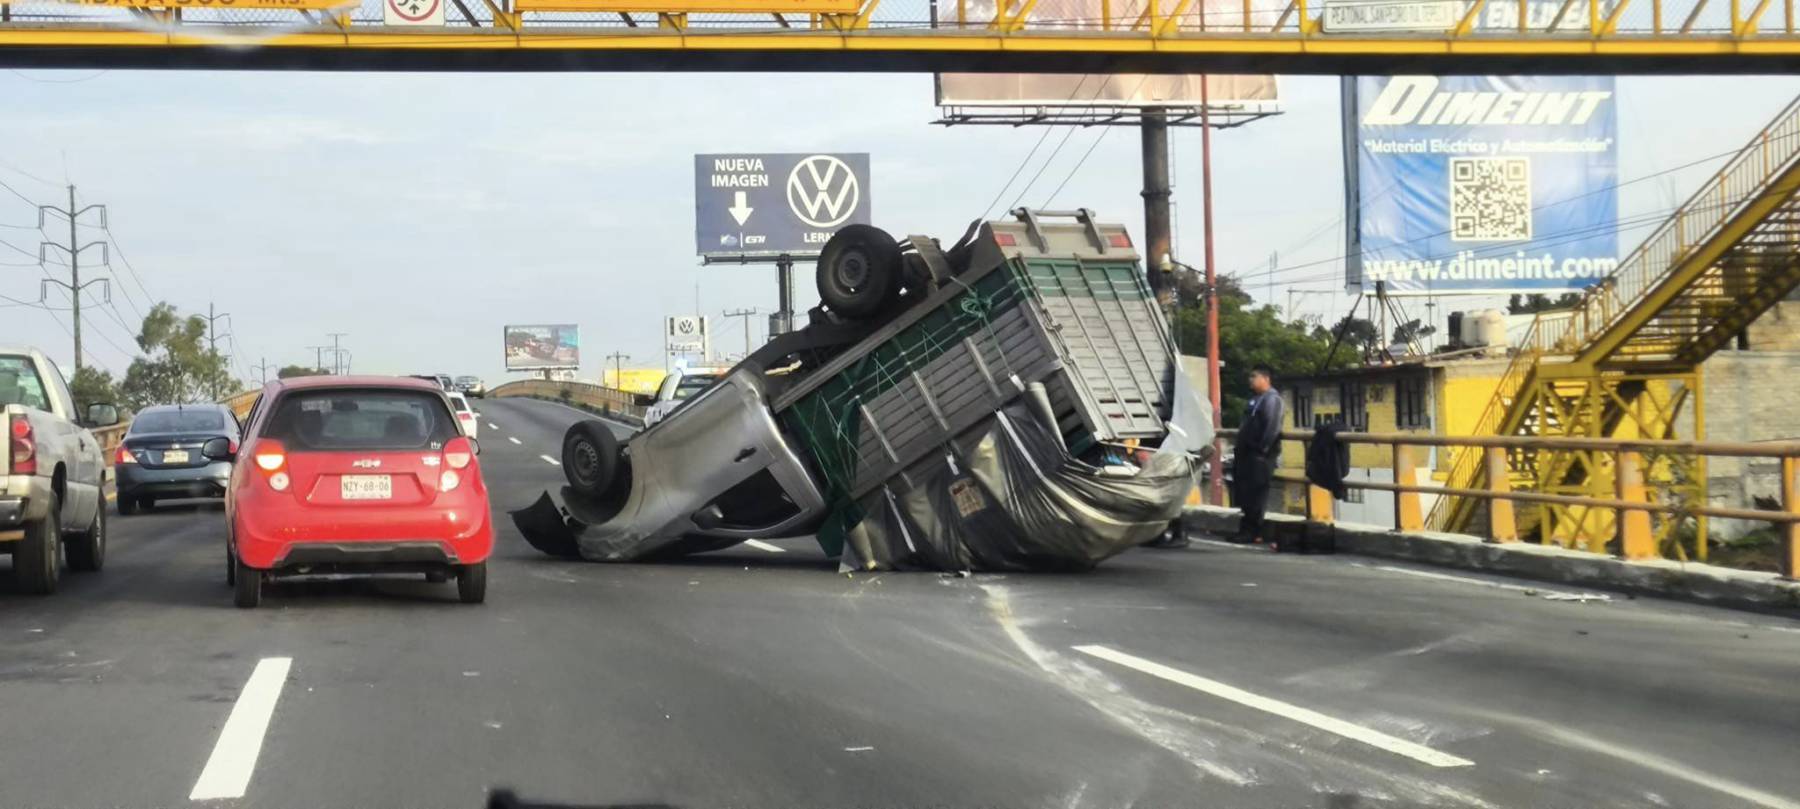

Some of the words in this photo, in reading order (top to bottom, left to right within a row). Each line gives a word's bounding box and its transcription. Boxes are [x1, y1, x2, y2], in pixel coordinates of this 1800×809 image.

[1491, 143, 1502, 155] y
[715, 159, 764, 172] NUEVA
[711, 174, 769, 187] IMAGEN
[1364, 251, 1618, 281] www.dimeint.com
